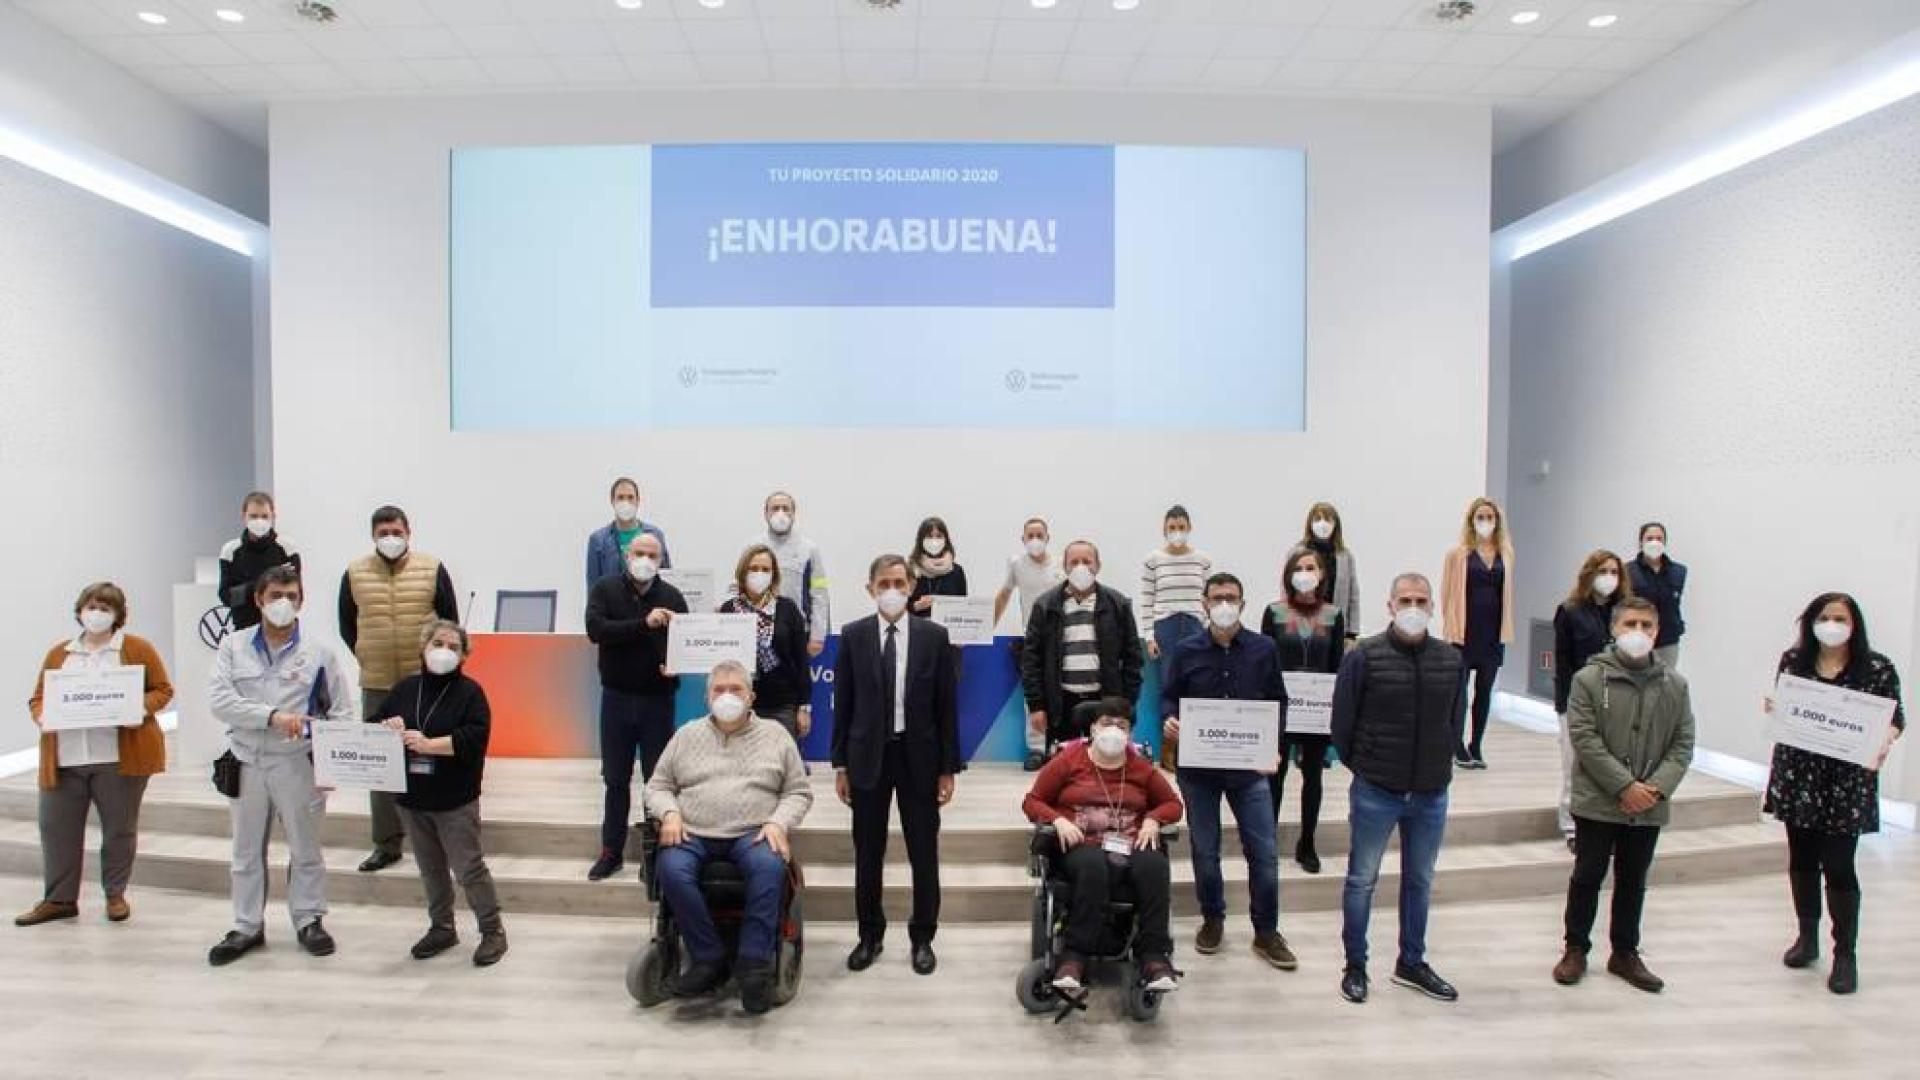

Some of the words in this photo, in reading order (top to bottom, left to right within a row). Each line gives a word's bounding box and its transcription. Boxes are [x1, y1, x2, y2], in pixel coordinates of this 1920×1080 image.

[768, 168, 788, 182] TU
[792, 168, 872, 182] PROYECTO
[875, 168, 958, 182] SOLIDARIO
[961, 168, 999, 182] 2020
[708, 217, 1057, 263] ¡ENHORABUENA!
[1791, 706, 1827, 722] 3.000
[1828, 718, 1863, 733] euros
[1198, 728, 1228, 738] 3.000
[1229, 731, 1260, 740] euros
[330, 750, 358, 761] 3.000
[358, 753, 387, 763] euros
